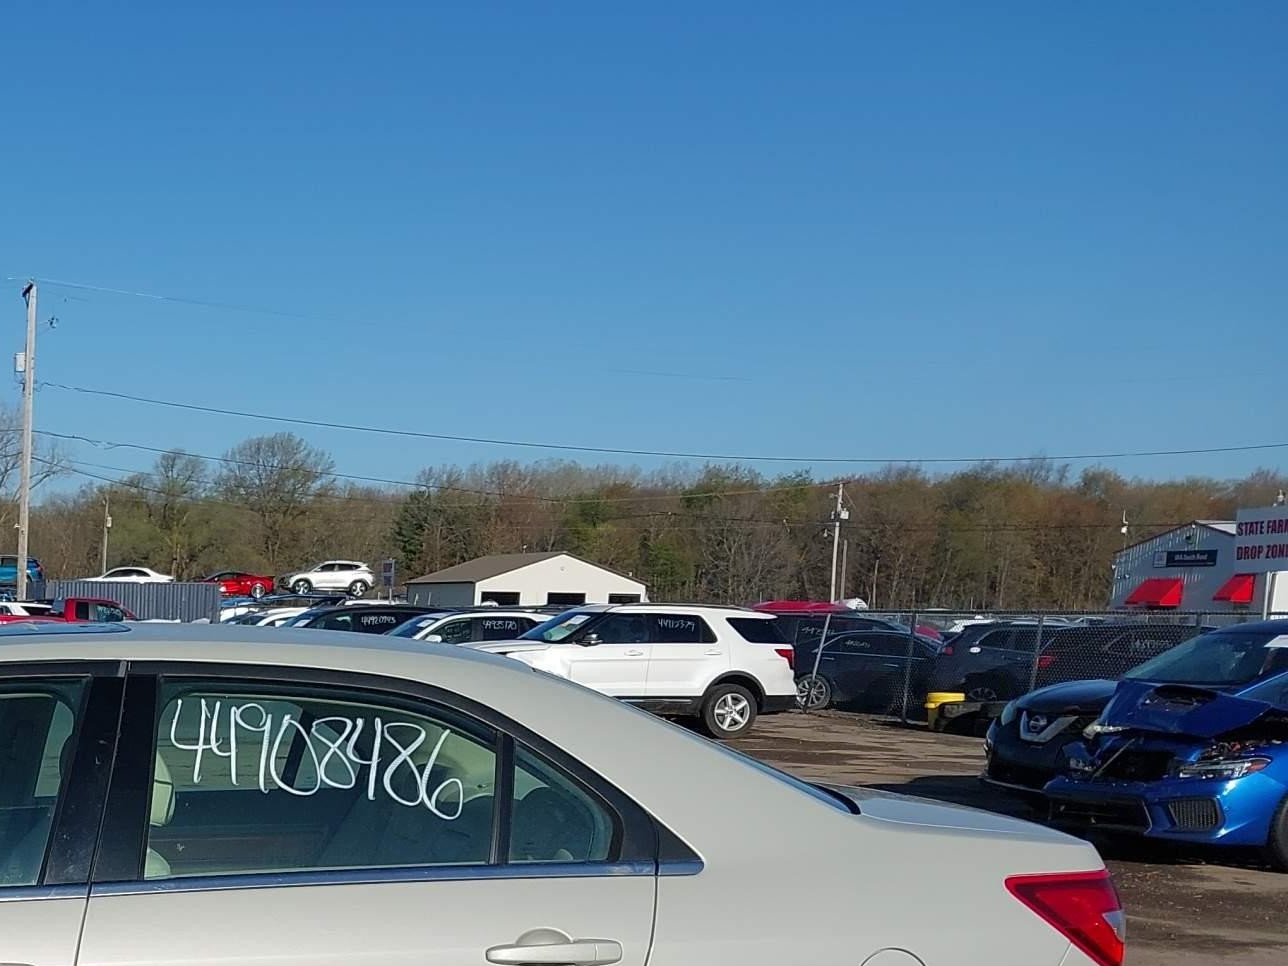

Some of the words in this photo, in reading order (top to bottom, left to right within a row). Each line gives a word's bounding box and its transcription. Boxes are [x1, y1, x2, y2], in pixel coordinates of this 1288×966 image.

[1237, 521, 1265, 536] STATE
[1236, 545, 1264, 560] DROP
[170, 698, 463, 820] 44908486
